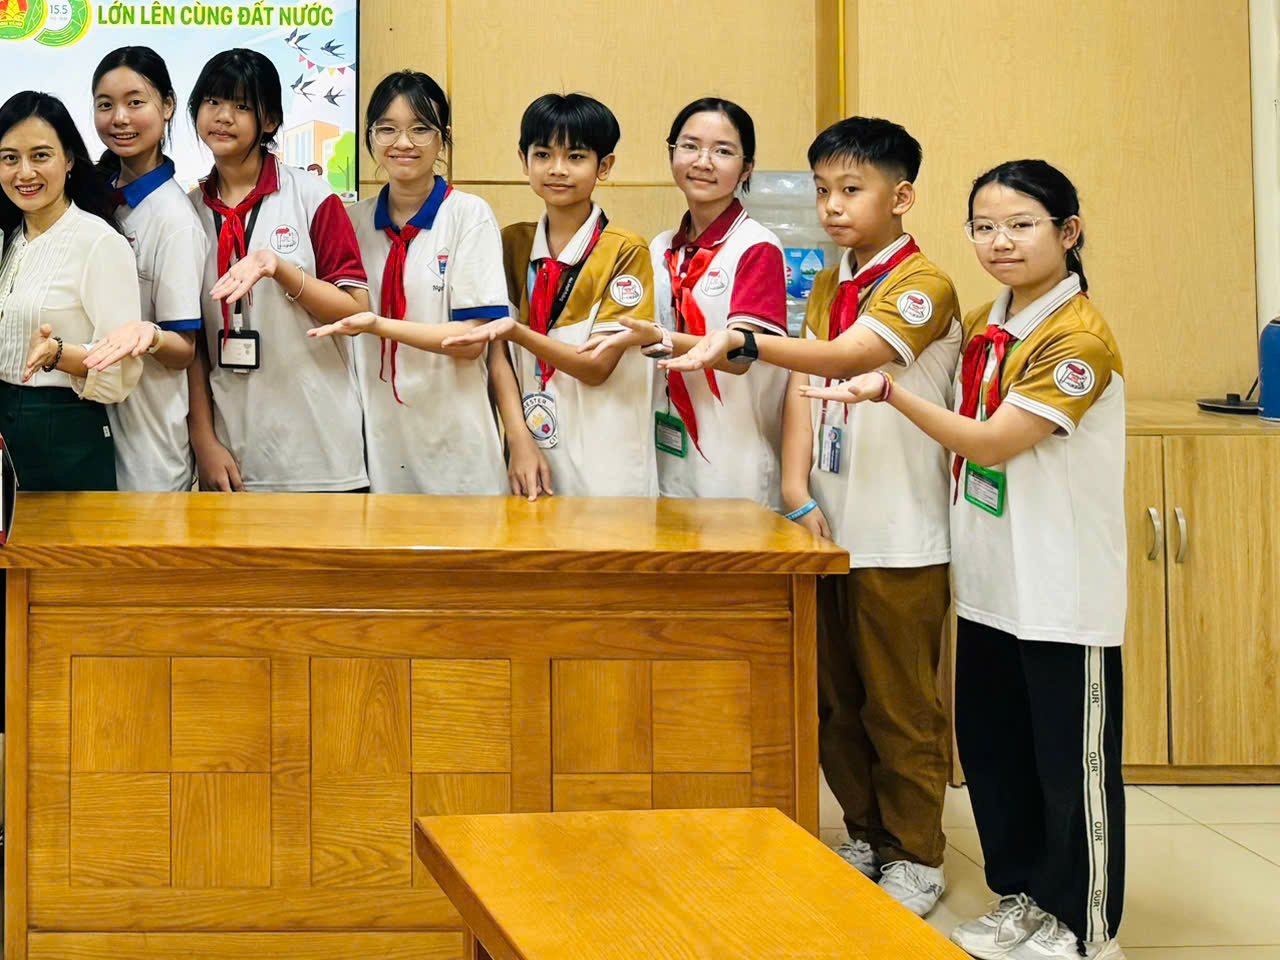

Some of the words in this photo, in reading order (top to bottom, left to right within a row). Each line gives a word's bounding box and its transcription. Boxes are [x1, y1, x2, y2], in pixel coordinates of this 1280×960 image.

[98, 0, 135, 25] LỚN
[140, 1, 175, 25] LÊN
[180, 1, 233, 26] CÙNG
[237, 0, 274, 26] ĐẤT
[279, 1, 333, 26] NƯỚC
[1091, 683, 1100, 704] OUR
[1089, 751, 1099, 772] OUR
[1094, 821, 1103, 842] OUR
[1093, 889, 1102, 908] OUR
